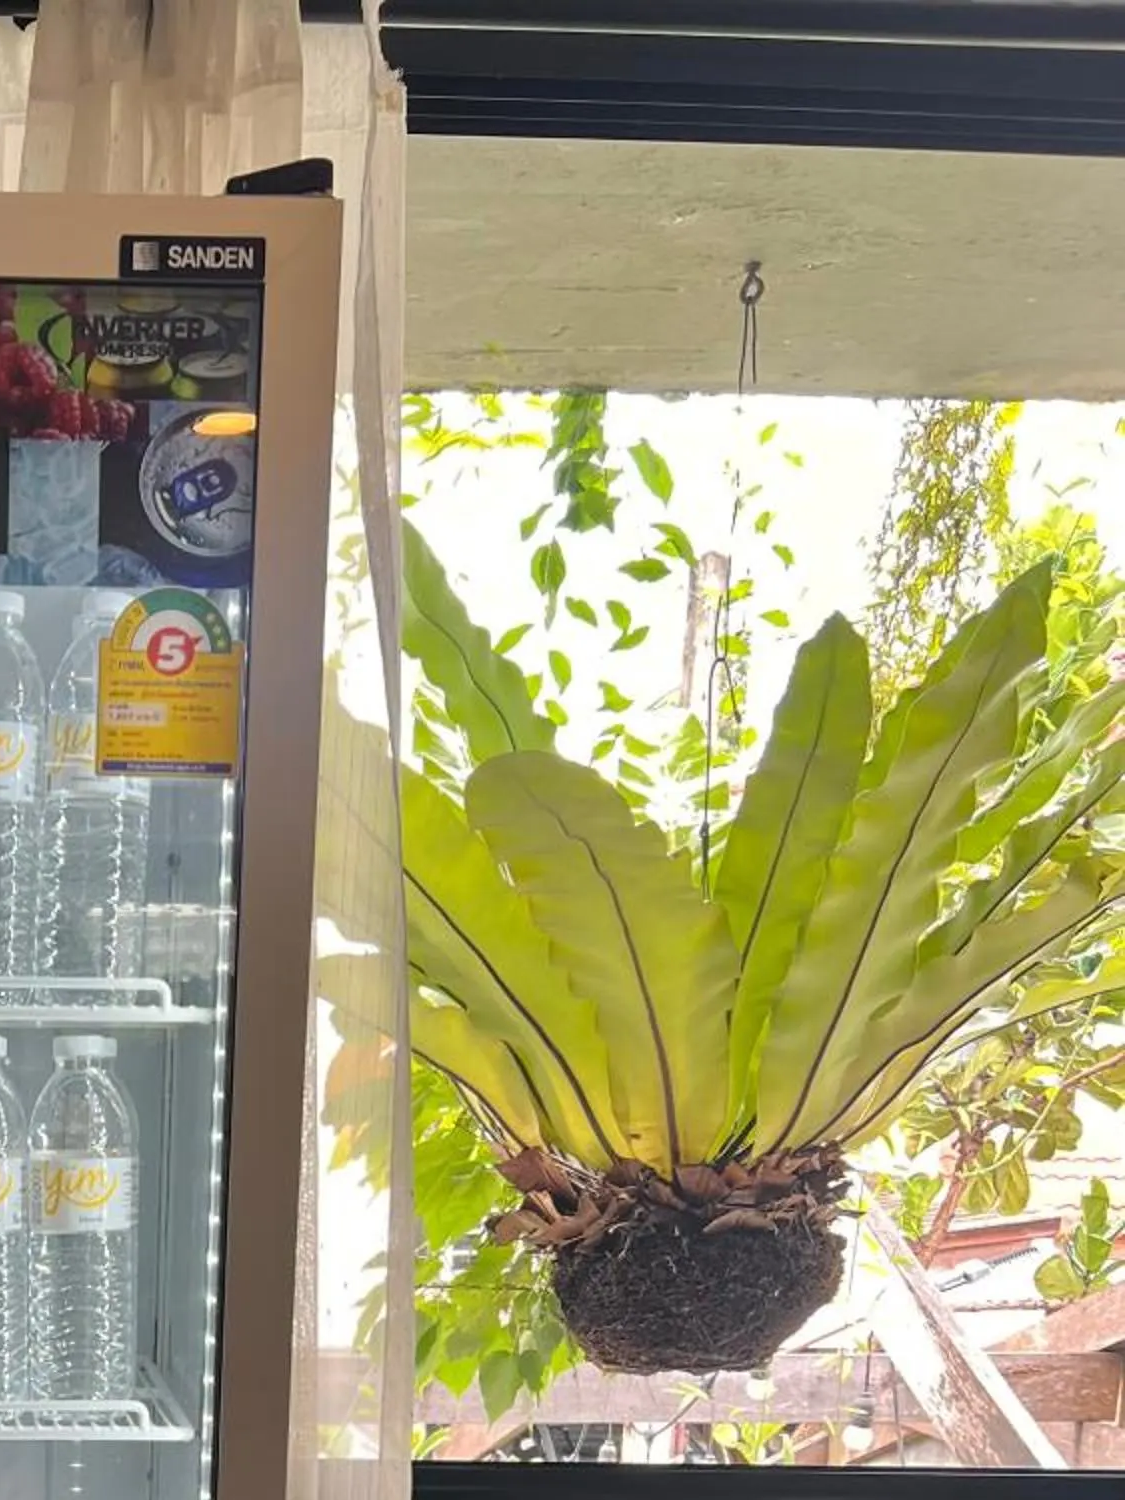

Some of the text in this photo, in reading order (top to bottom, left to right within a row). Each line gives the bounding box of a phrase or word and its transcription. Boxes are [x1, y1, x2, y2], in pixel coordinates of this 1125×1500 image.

[168, 245, 254, 270] SANDEN
[155, 633, 186, 671] 5
[42, 1160, 116, 1217] yim
